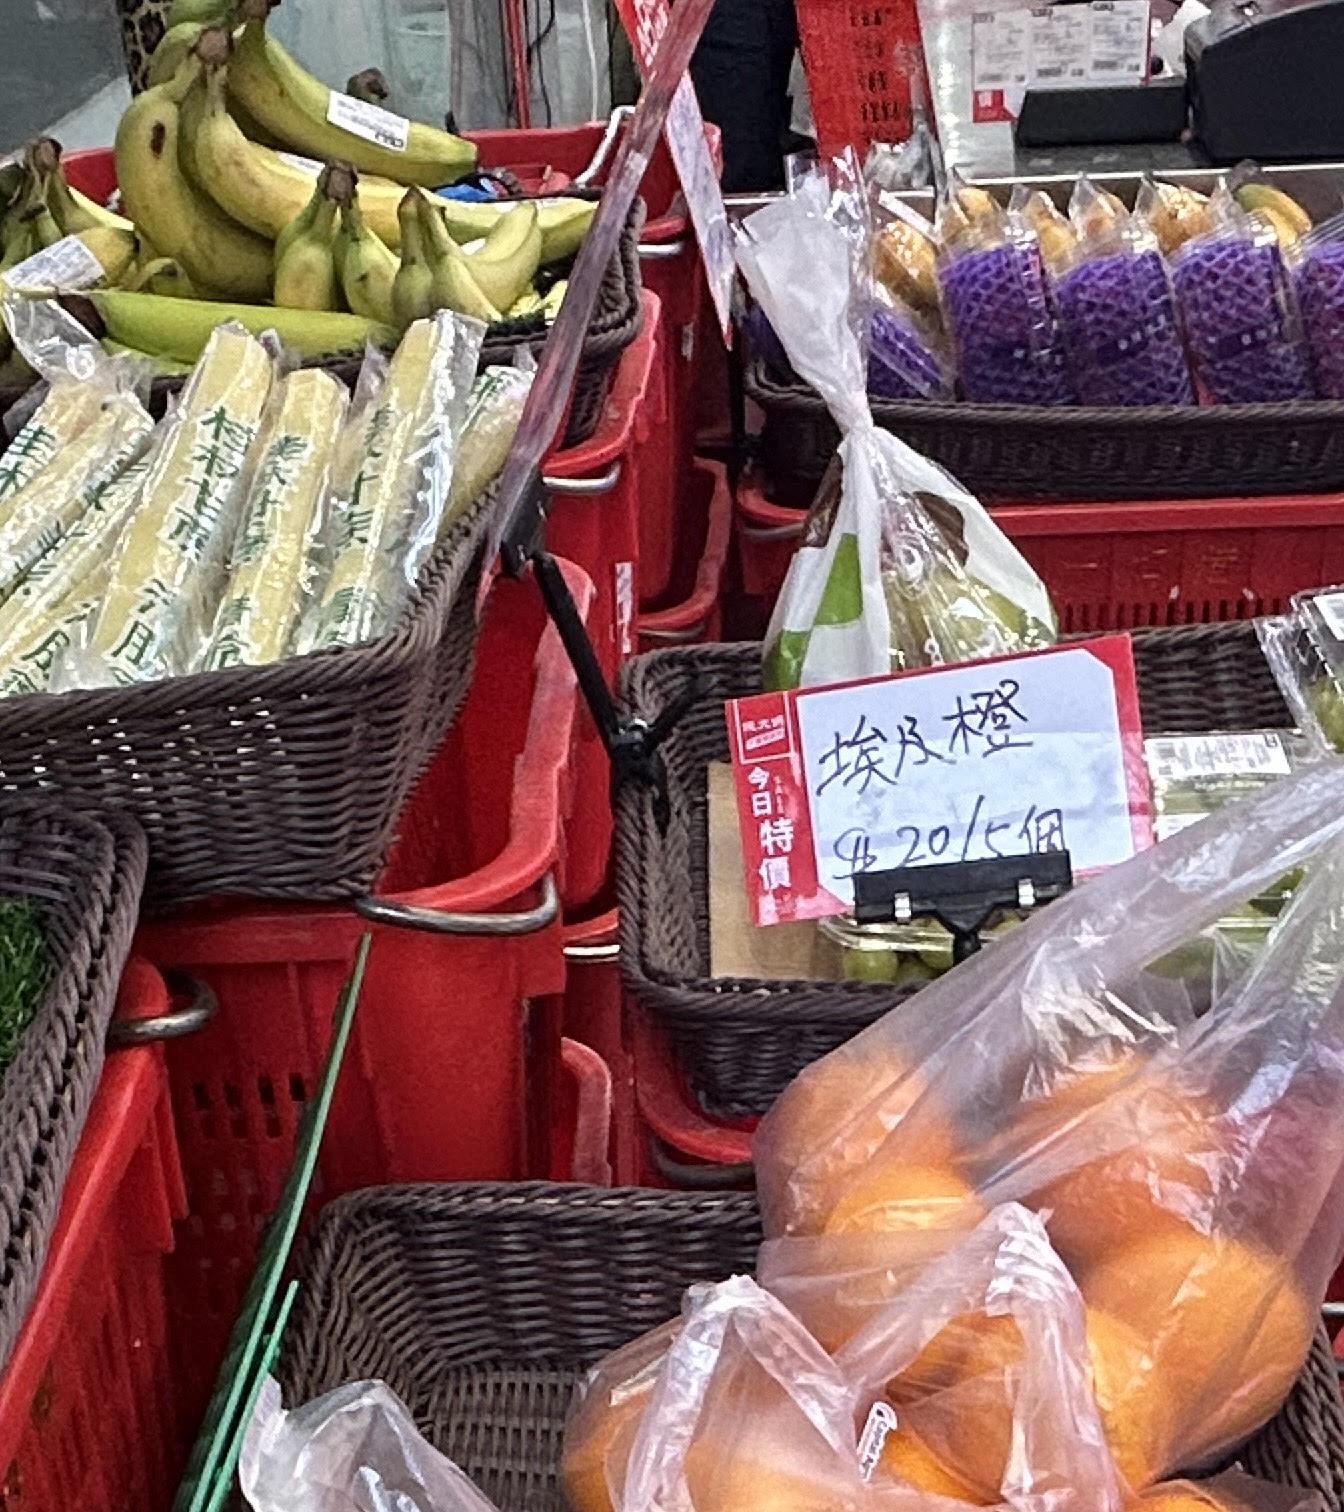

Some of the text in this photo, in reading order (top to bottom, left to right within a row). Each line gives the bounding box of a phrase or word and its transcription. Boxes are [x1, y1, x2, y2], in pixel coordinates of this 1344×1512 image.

[816, 679, 1034, 798] 埃及橙
[747, 765, 795, 893] 今日特價
